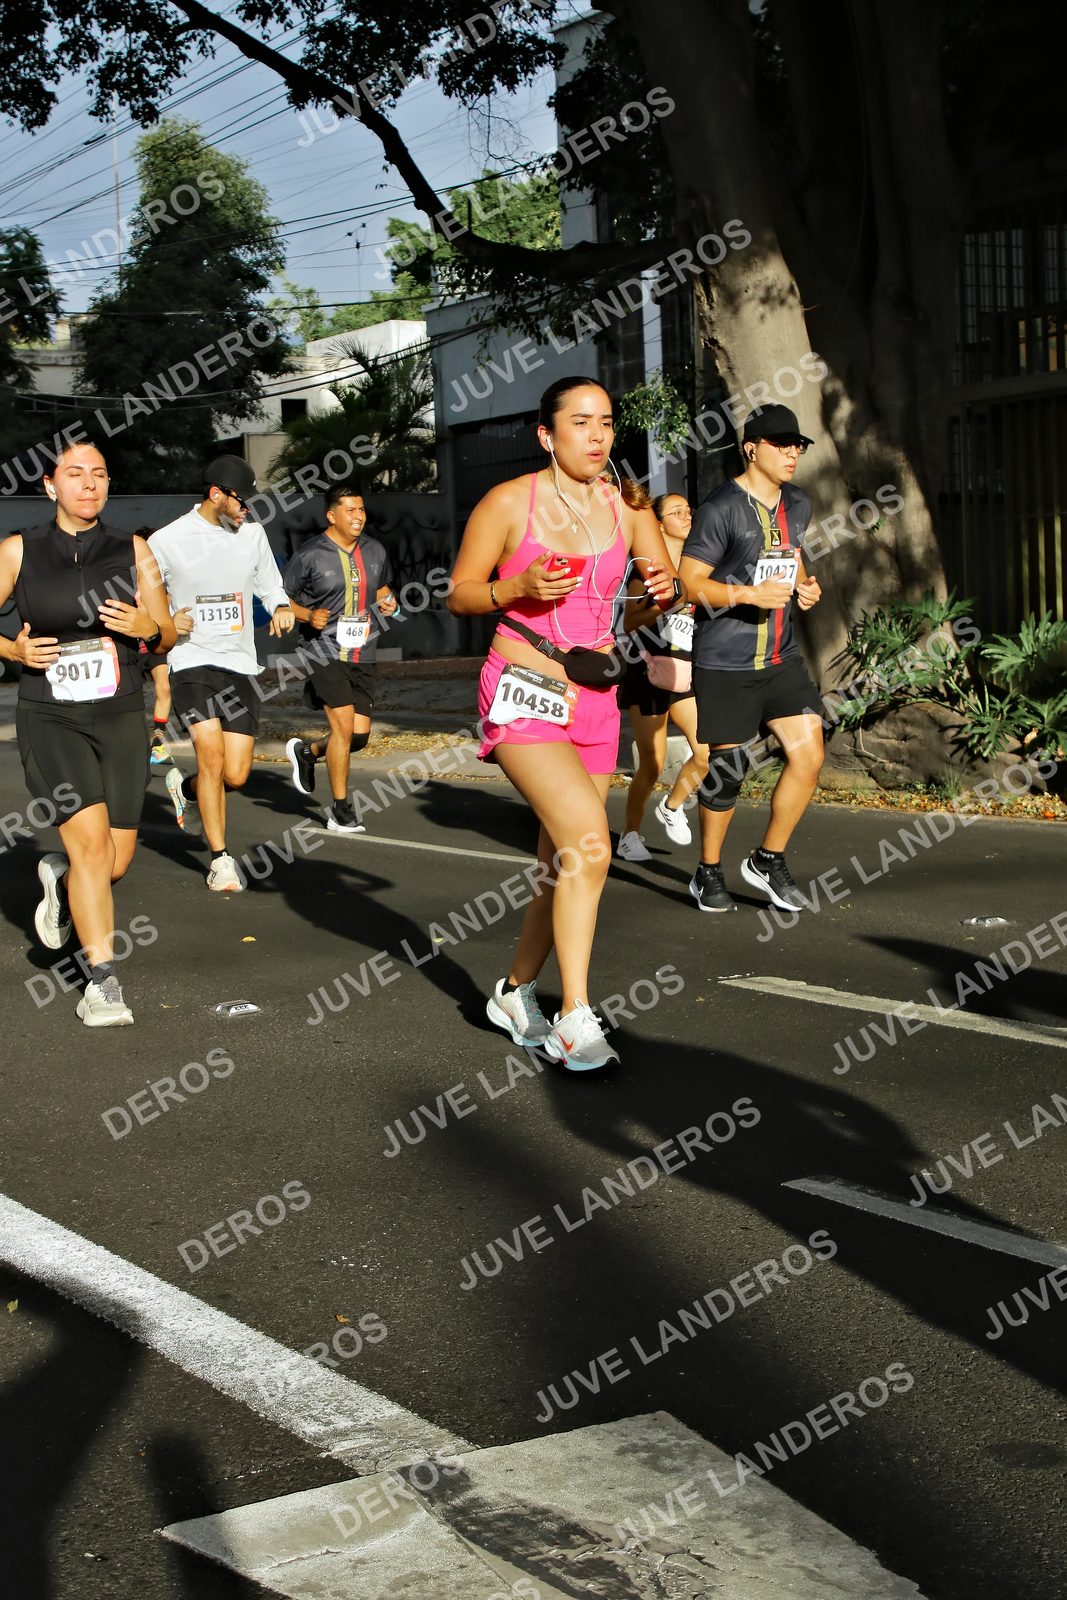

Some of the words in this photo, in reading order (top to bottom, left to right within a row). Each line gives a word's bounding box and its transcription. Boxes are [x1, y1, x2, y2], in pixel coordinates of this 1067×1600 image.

[199, 606, 239, 621] 13158
[346, 627, 363, 637] 468
[56, 659, 103, 683] 9017
[502, 682, 564, 718] 10458
